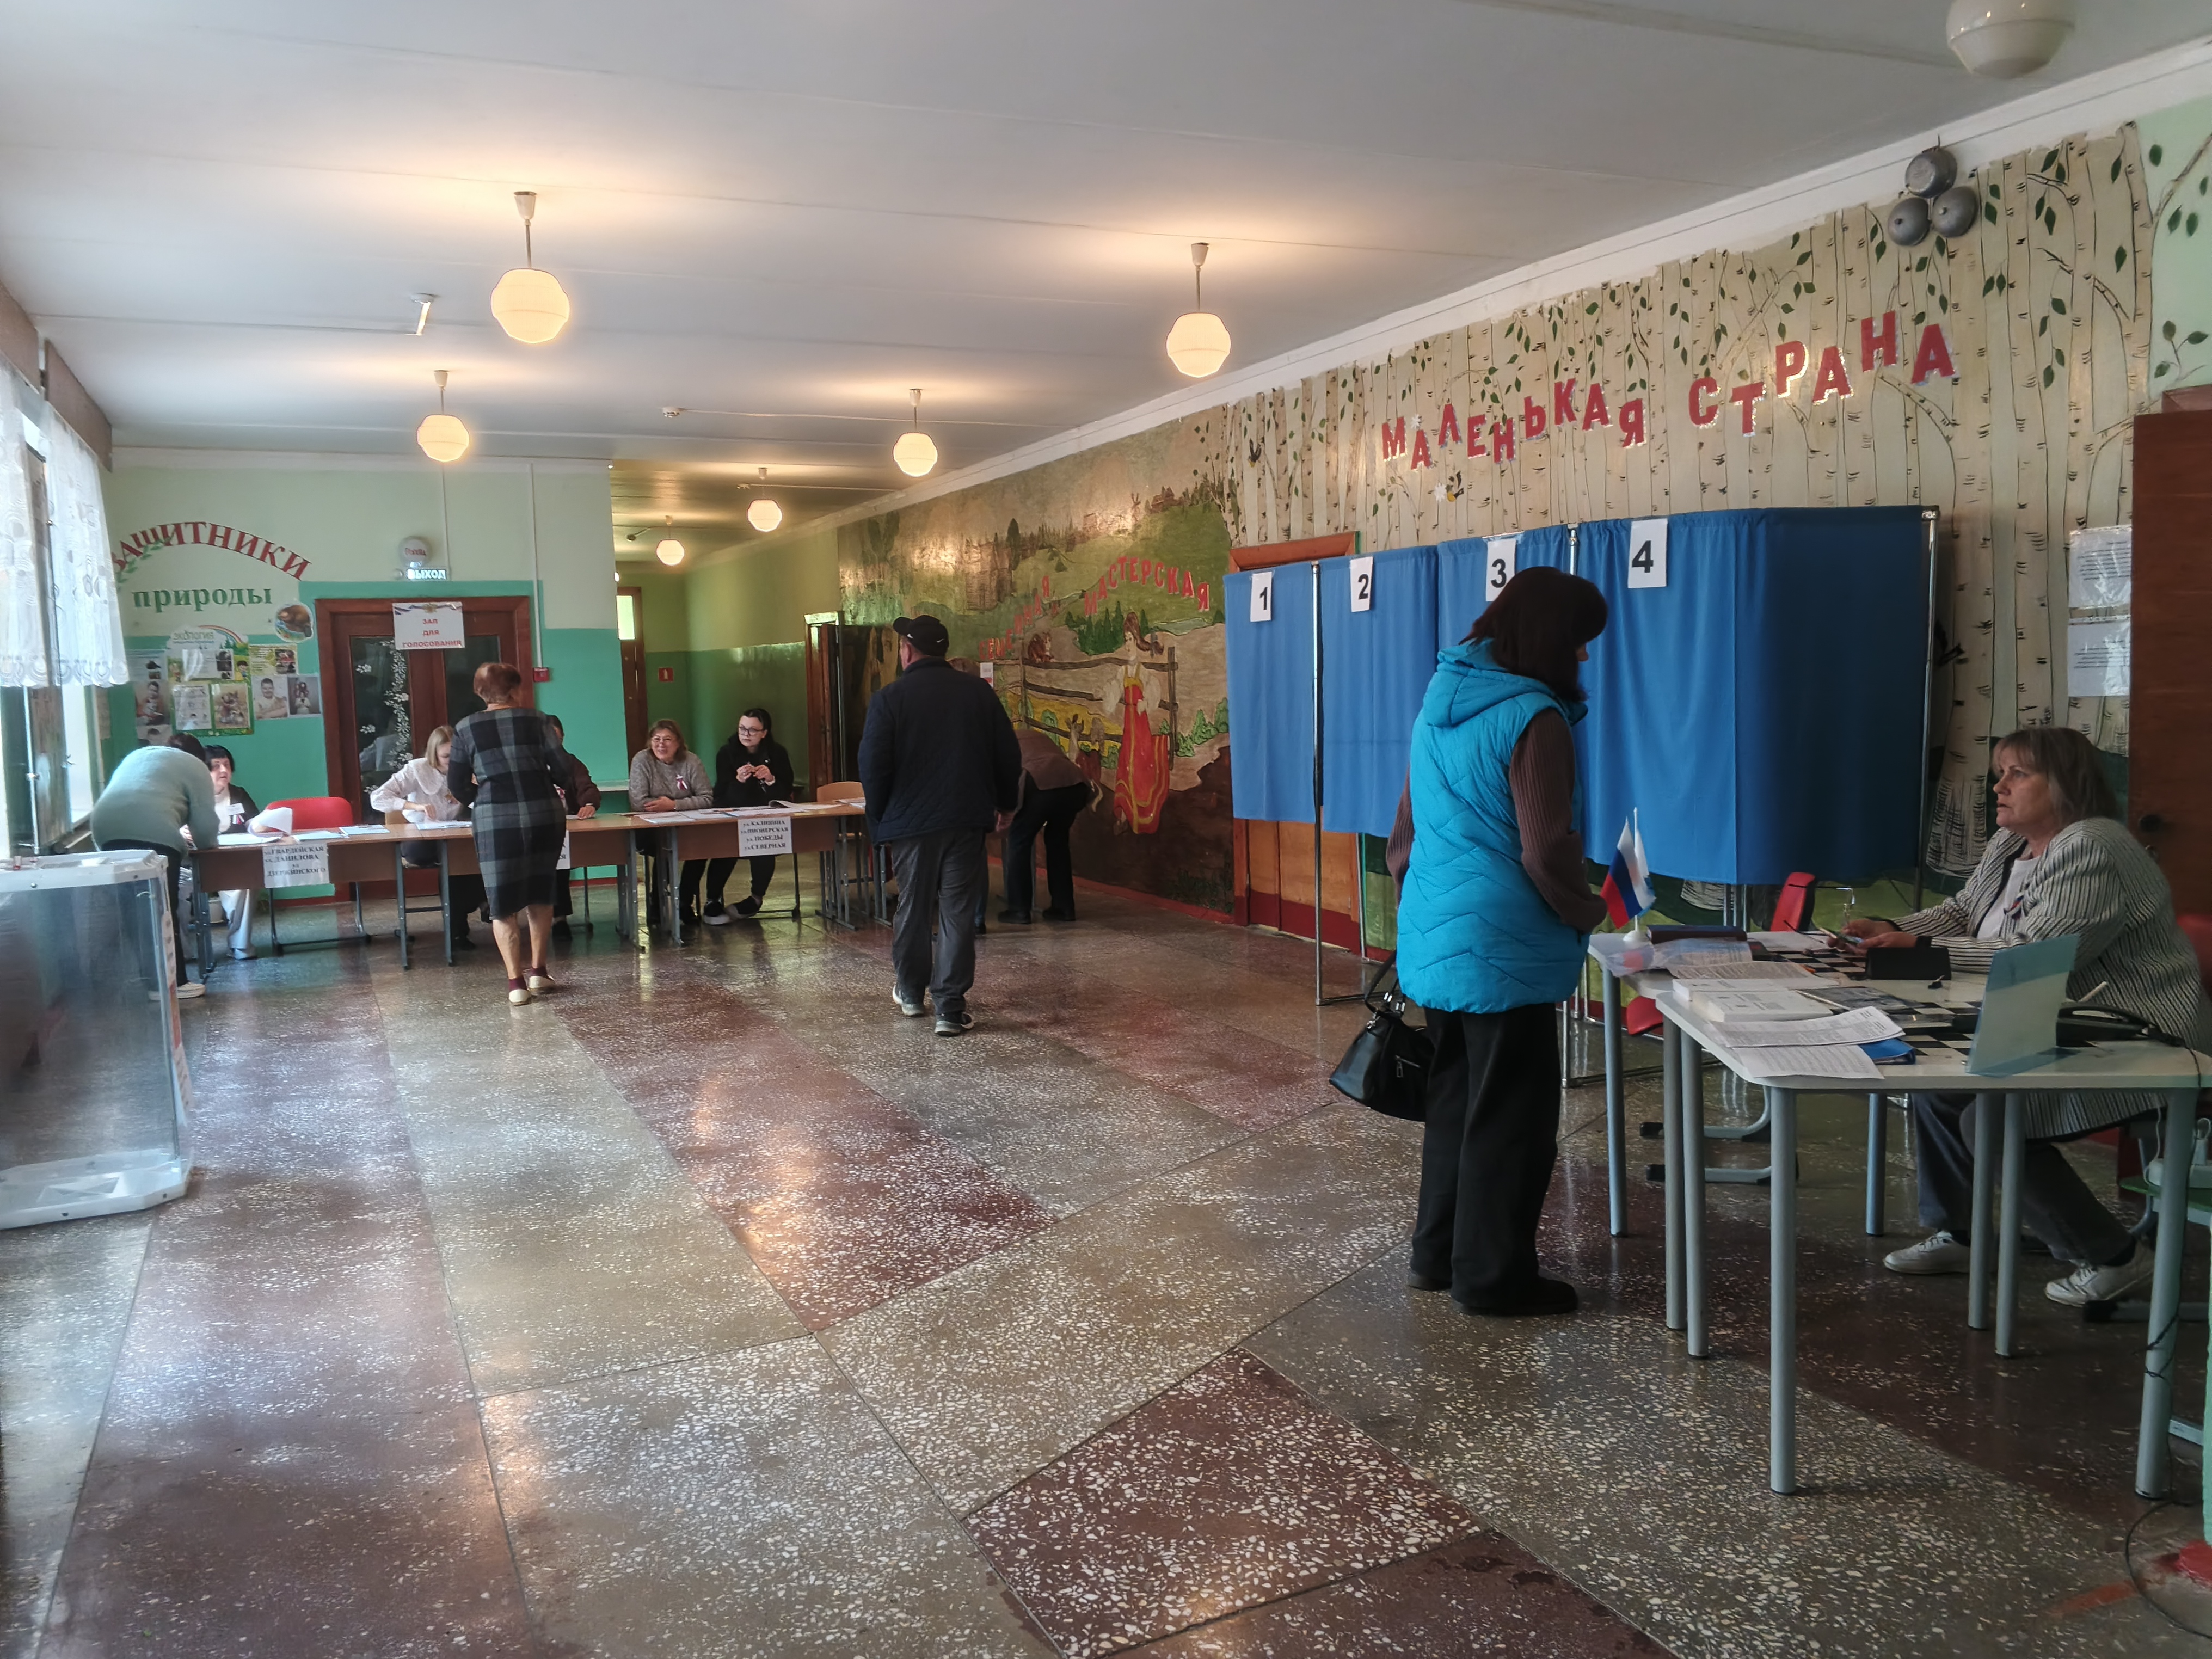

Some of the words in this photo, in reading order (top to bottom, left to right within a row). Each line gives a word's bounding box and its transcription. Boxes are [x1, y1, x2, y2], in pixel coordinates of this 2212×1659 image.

[1381, 378, 1646, 470] МАЛЕНЬКАЯ
[1688, 310, 1958, 437] СТРАНА
[1631, 540, 1654, 573] 4
[407, 569, 447, 580] ВЫХОД
[1084, 556, 1210, 616] МАСТЕРСКАЯ
[1358, 573, 1369, 600] 2
[1490, 558, 1507, 588] 3
[132, 588, 273, 613] природы
[1259, 586, 1268, 611] 1
